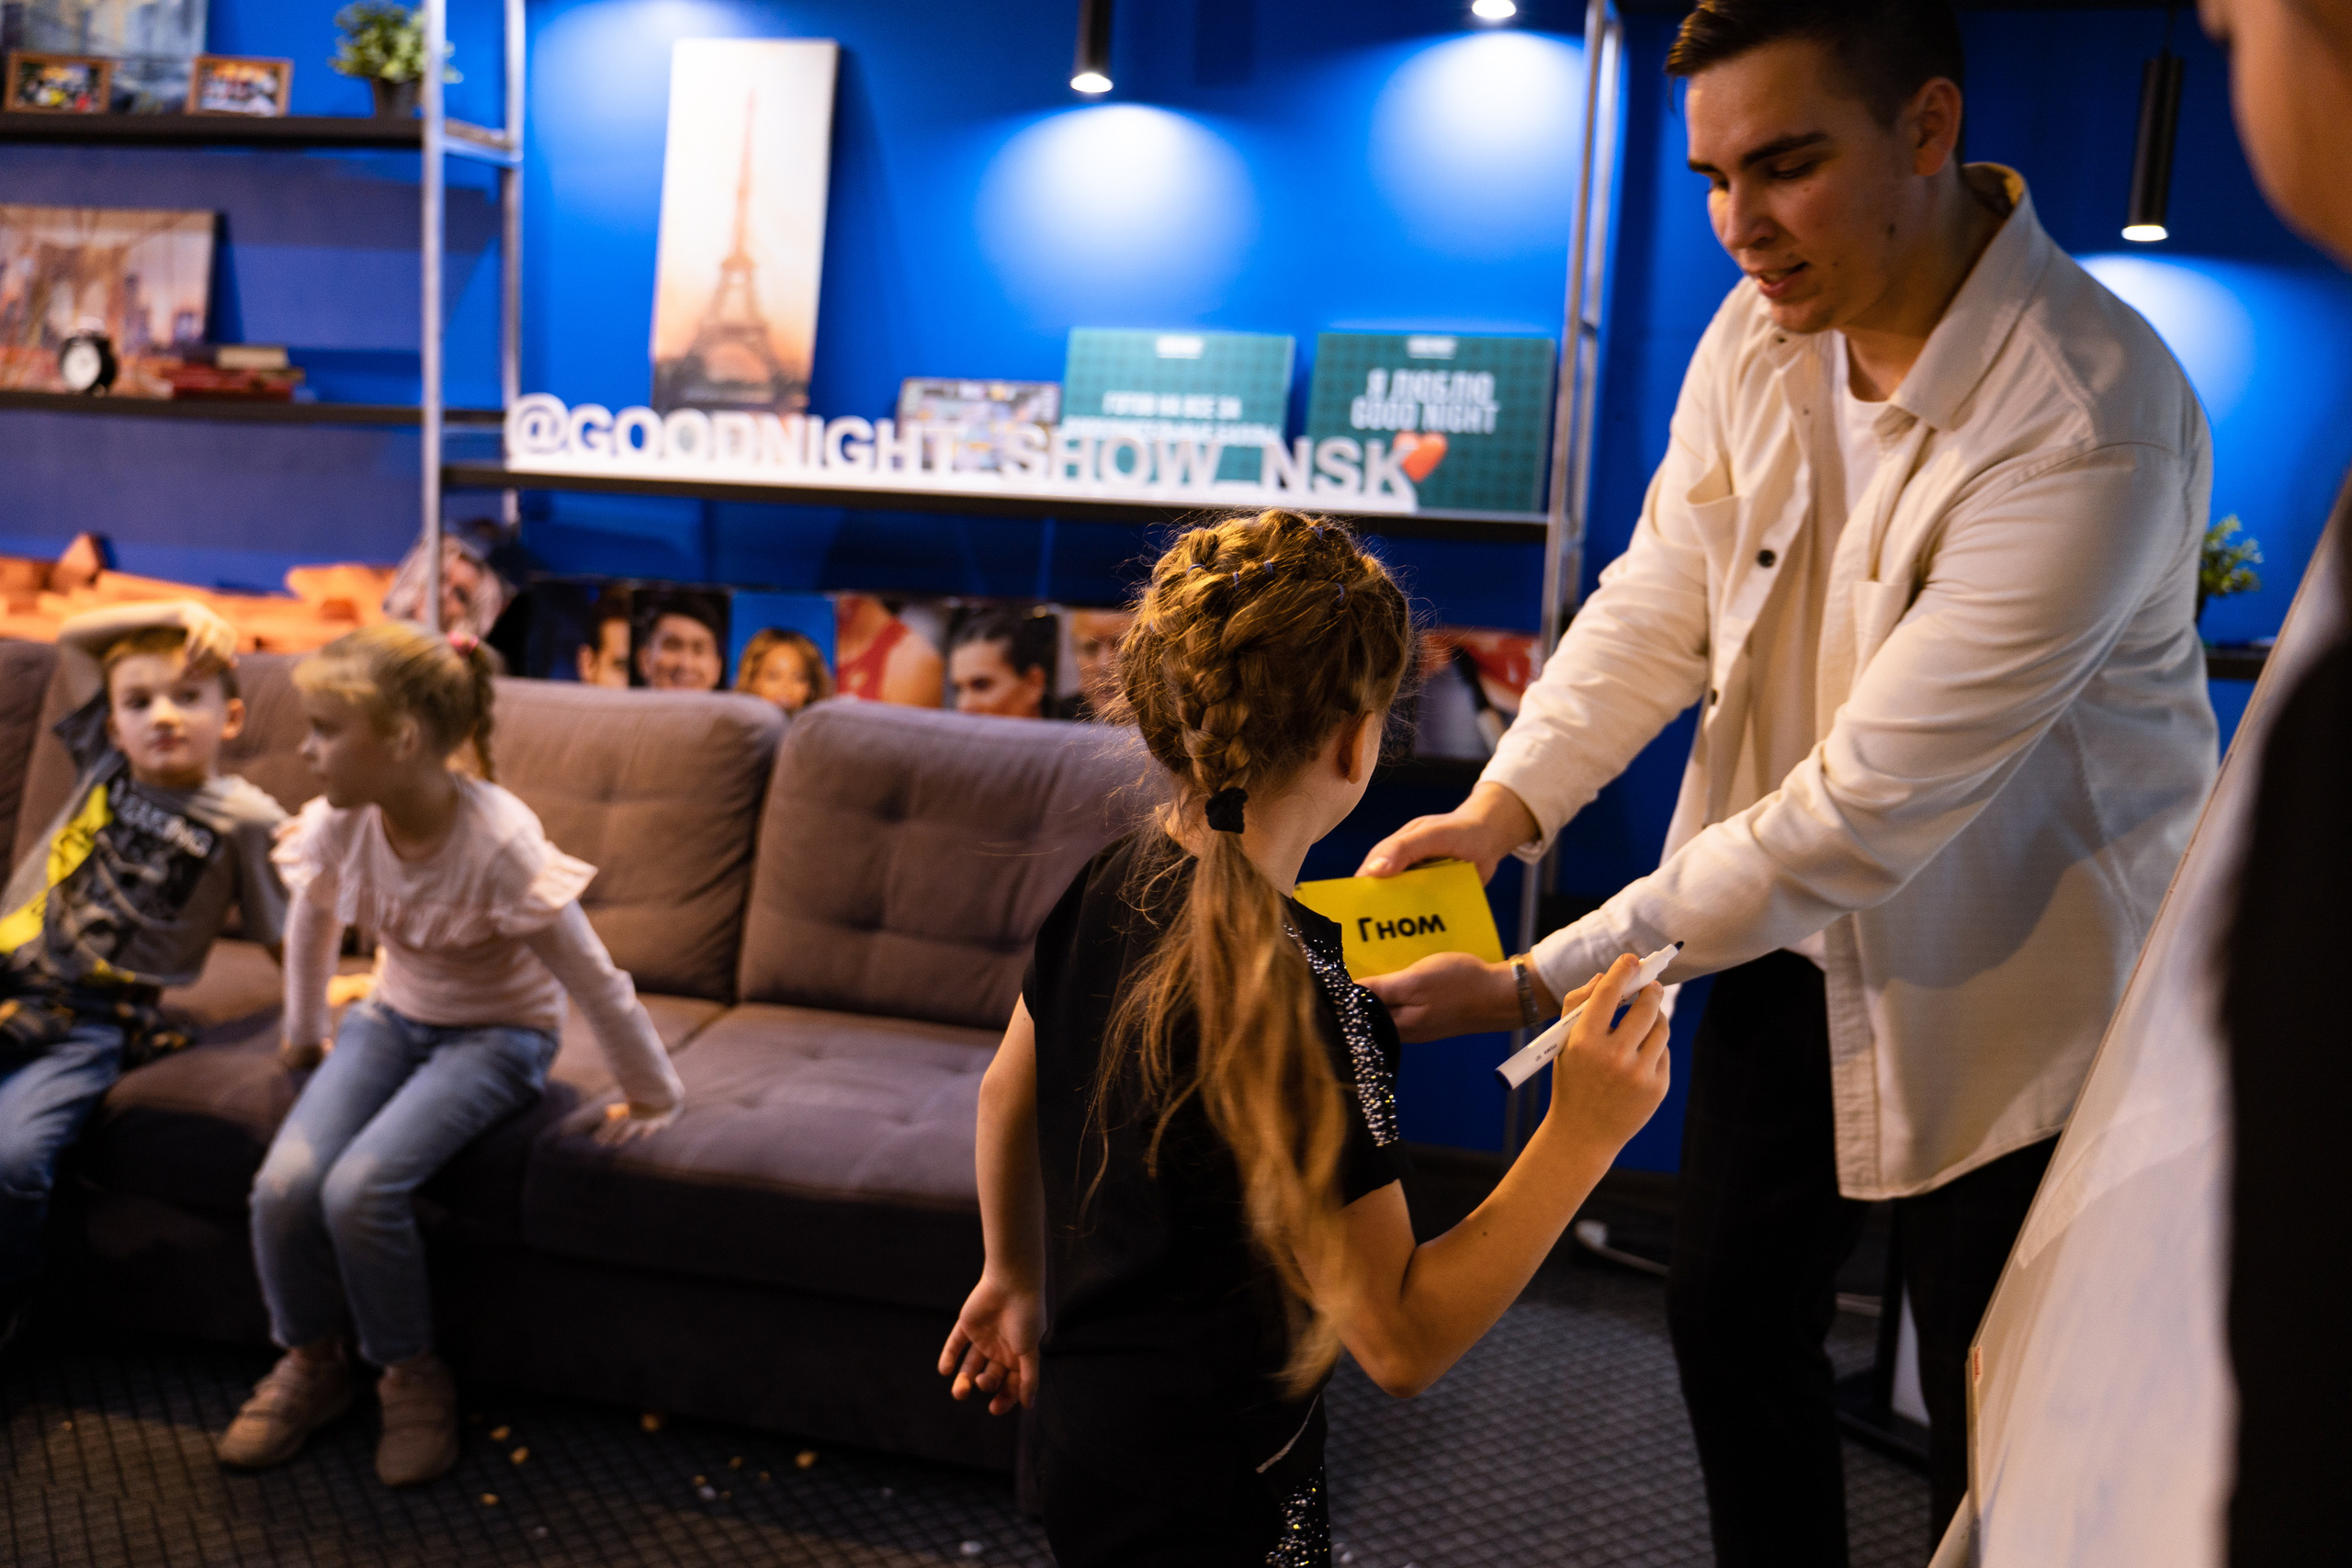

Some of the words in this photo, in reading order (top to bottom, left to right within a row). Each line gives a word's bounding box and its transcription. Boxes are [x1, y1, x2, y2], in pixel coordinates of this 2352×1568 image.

[1366, 368, 1388, 402] Я
[1389, 369, 1496, 406] ЛЮБЛЮ
[1351, 395, 1418, 432] GOOD
[1421, 400, 1498, 434] NIGHT
[1358, 914, 1446, 942] Гном
